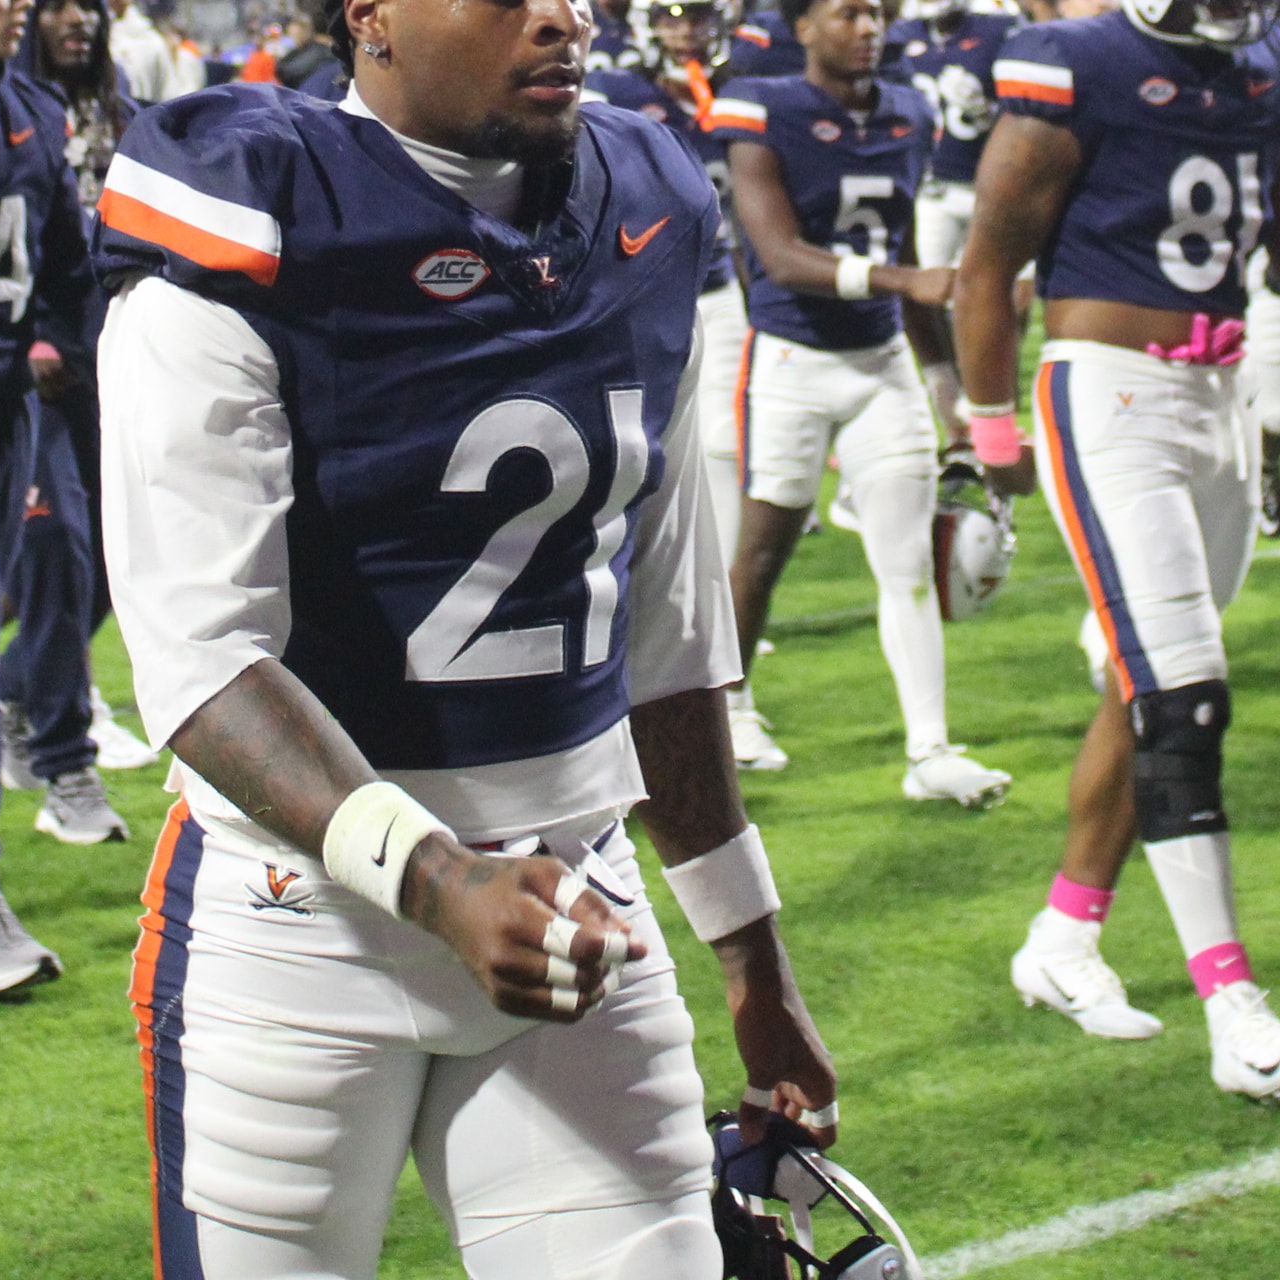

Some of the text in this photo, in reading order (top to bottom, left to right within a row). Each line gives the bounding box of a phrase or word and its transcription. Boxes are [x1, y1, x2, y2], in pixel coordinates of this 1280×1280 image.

[424, 261, 482, 279] ACC
[832, 176, 895, 266] 5
[1157, 152, 1264, 294] 81
[406, 388, 649, 682] 21
